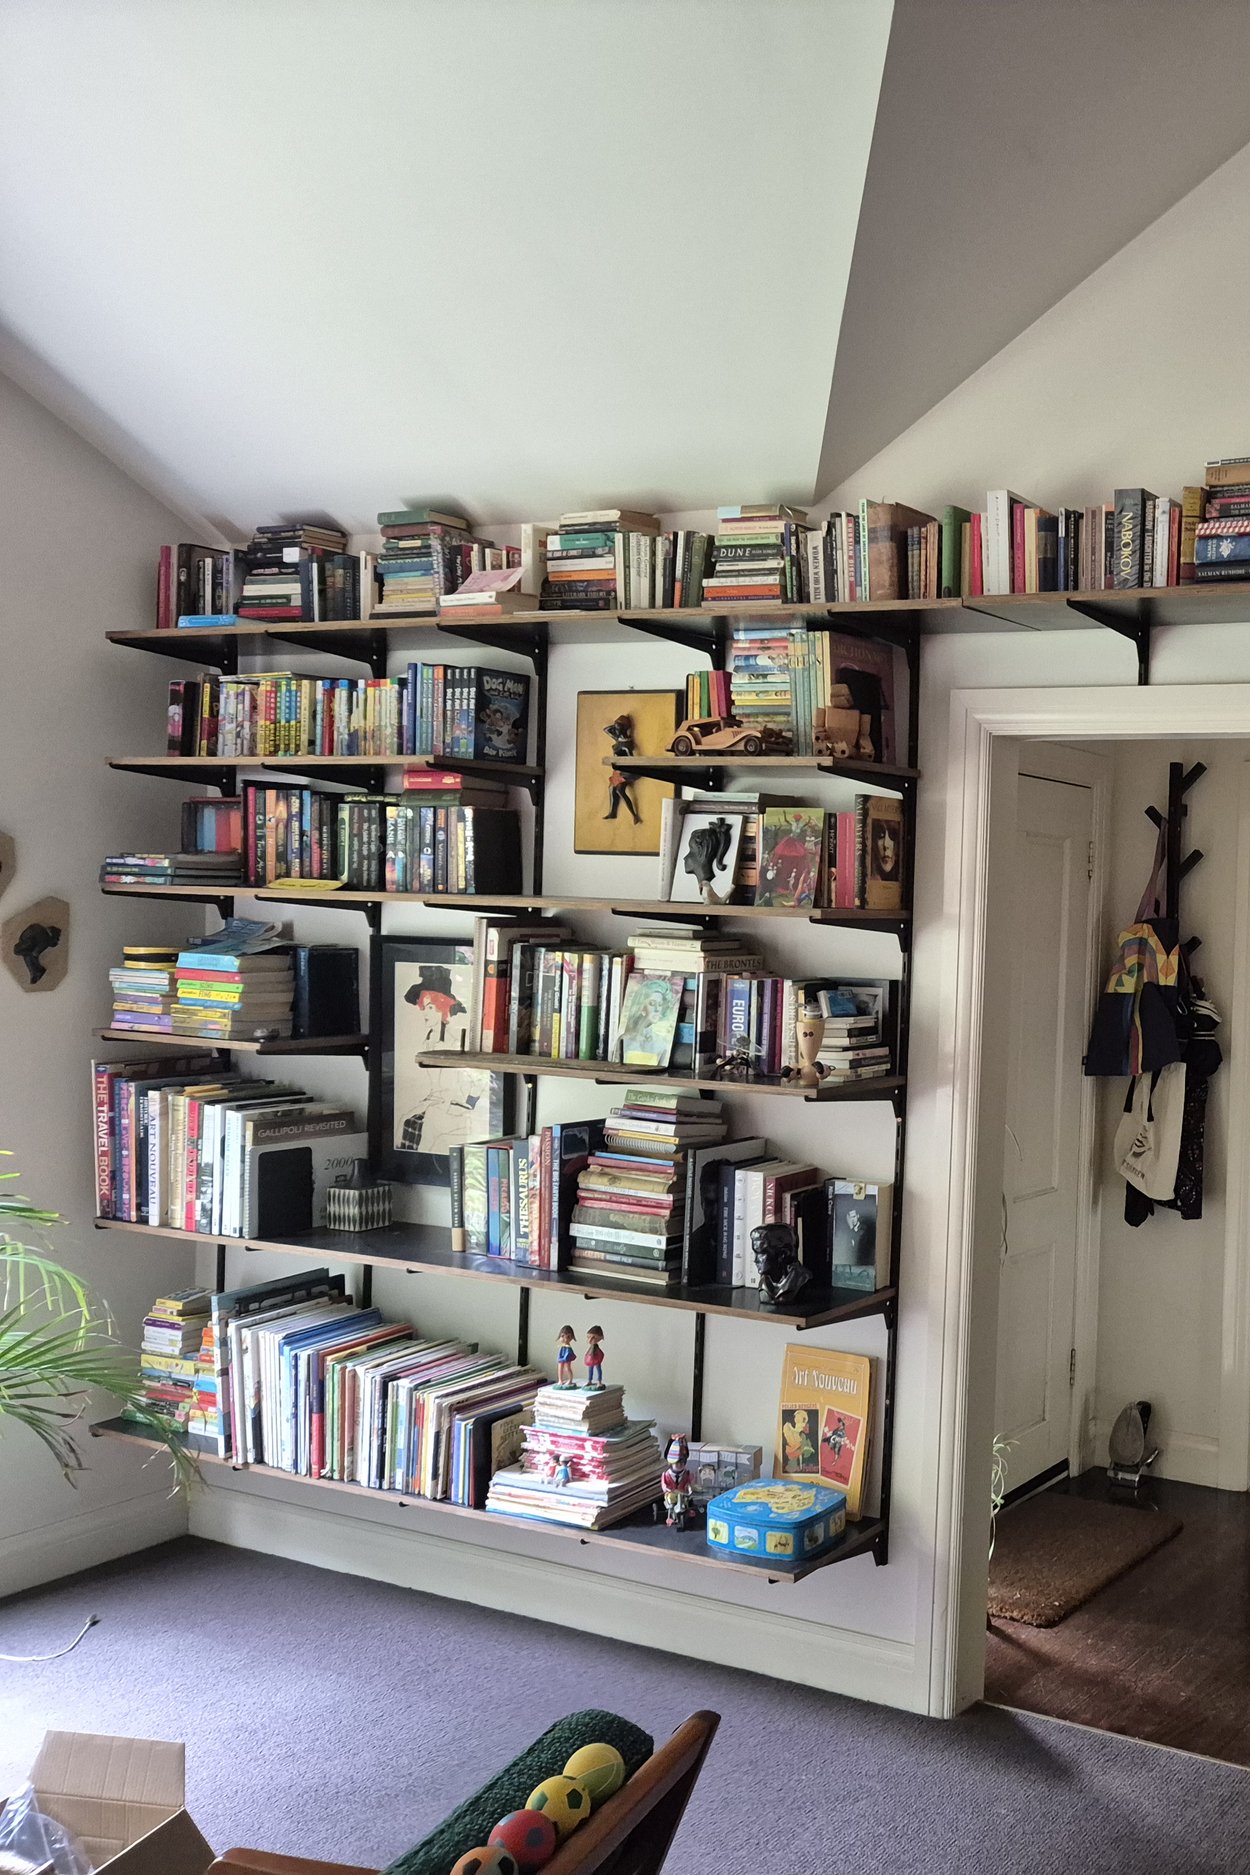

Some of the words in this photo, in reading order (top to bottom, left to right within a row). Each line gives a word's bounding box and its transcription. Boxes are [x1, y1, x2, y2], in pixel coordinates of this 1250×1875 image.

[1145, 501, 1153, 529] NABOKOV
[720, 547, 752, 558] DUNE
[1120, 511, 1134, 580] NABOKOV
[1144, 532, 1152, 564] LAUGHTER
[1144, 572, 1152, 581] the
[483, 676, 502, 690] DOG
[503, 677, 525, 694] MAN
[706, 959, 722, 970] THE
[723, 958, 762, 969] BRONTES
[97, 1075, 107, 1102] THE
[98, 1104, 108, 1154] TRAVEL
[149, 1114, 157, 1138] ART
[258, 1124, 303, 1138] GALLIPOLI
[304, 1120, 347, 1133] REVISITED
[99, 1156, 109, 1195] BOOK
[149, 1142, 157, 1205] NOUVEAU
[324, 1156, 354, 1171] 2000
[518, 1158, 529, 1235] THESAURUS
[791, 1365, 809, 1387] Art
[812, 1368, 859, 1396] Nouveau
